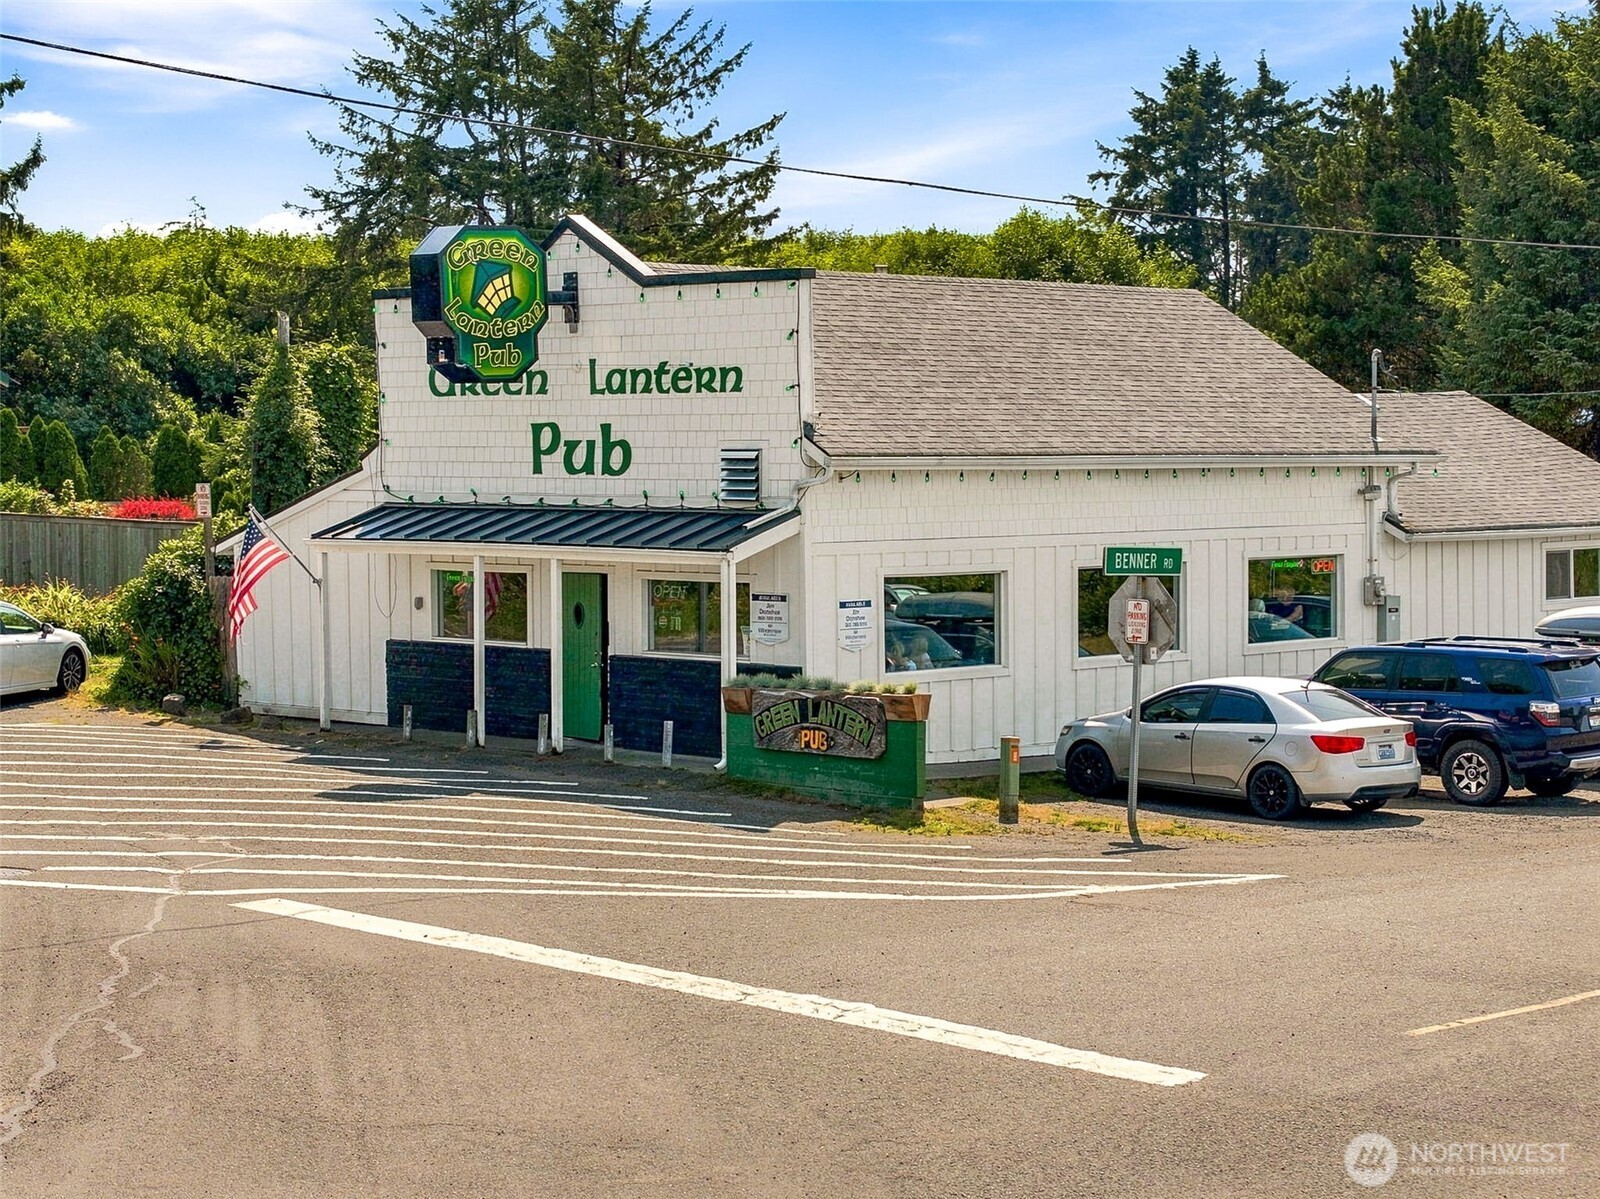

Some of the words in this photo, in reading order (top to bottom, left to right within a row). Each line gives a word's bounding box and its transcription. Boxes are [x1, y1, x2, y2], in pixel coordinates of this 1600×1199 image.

[447, 239, 539, 272] Green
[444, 297, 546, 338] Lantern
[473, 342, 522, 367] Pub
[589, 358, 743, 395] Lantern
[530, 422, 632, 476] Pub
[1115, 553, 1157, 569] BENNER
[1163, 558, 1174, 569] RD
[1312, 560, 1334, 572] OPEN
[654, 585, 687, 599] OPEN
[1133, 602, 1143, 611] NO
[755, 701, 800, 737] GREEN
[807, 699, 876, 747] LANTERN
[801, 729, 828, 750] PUB
